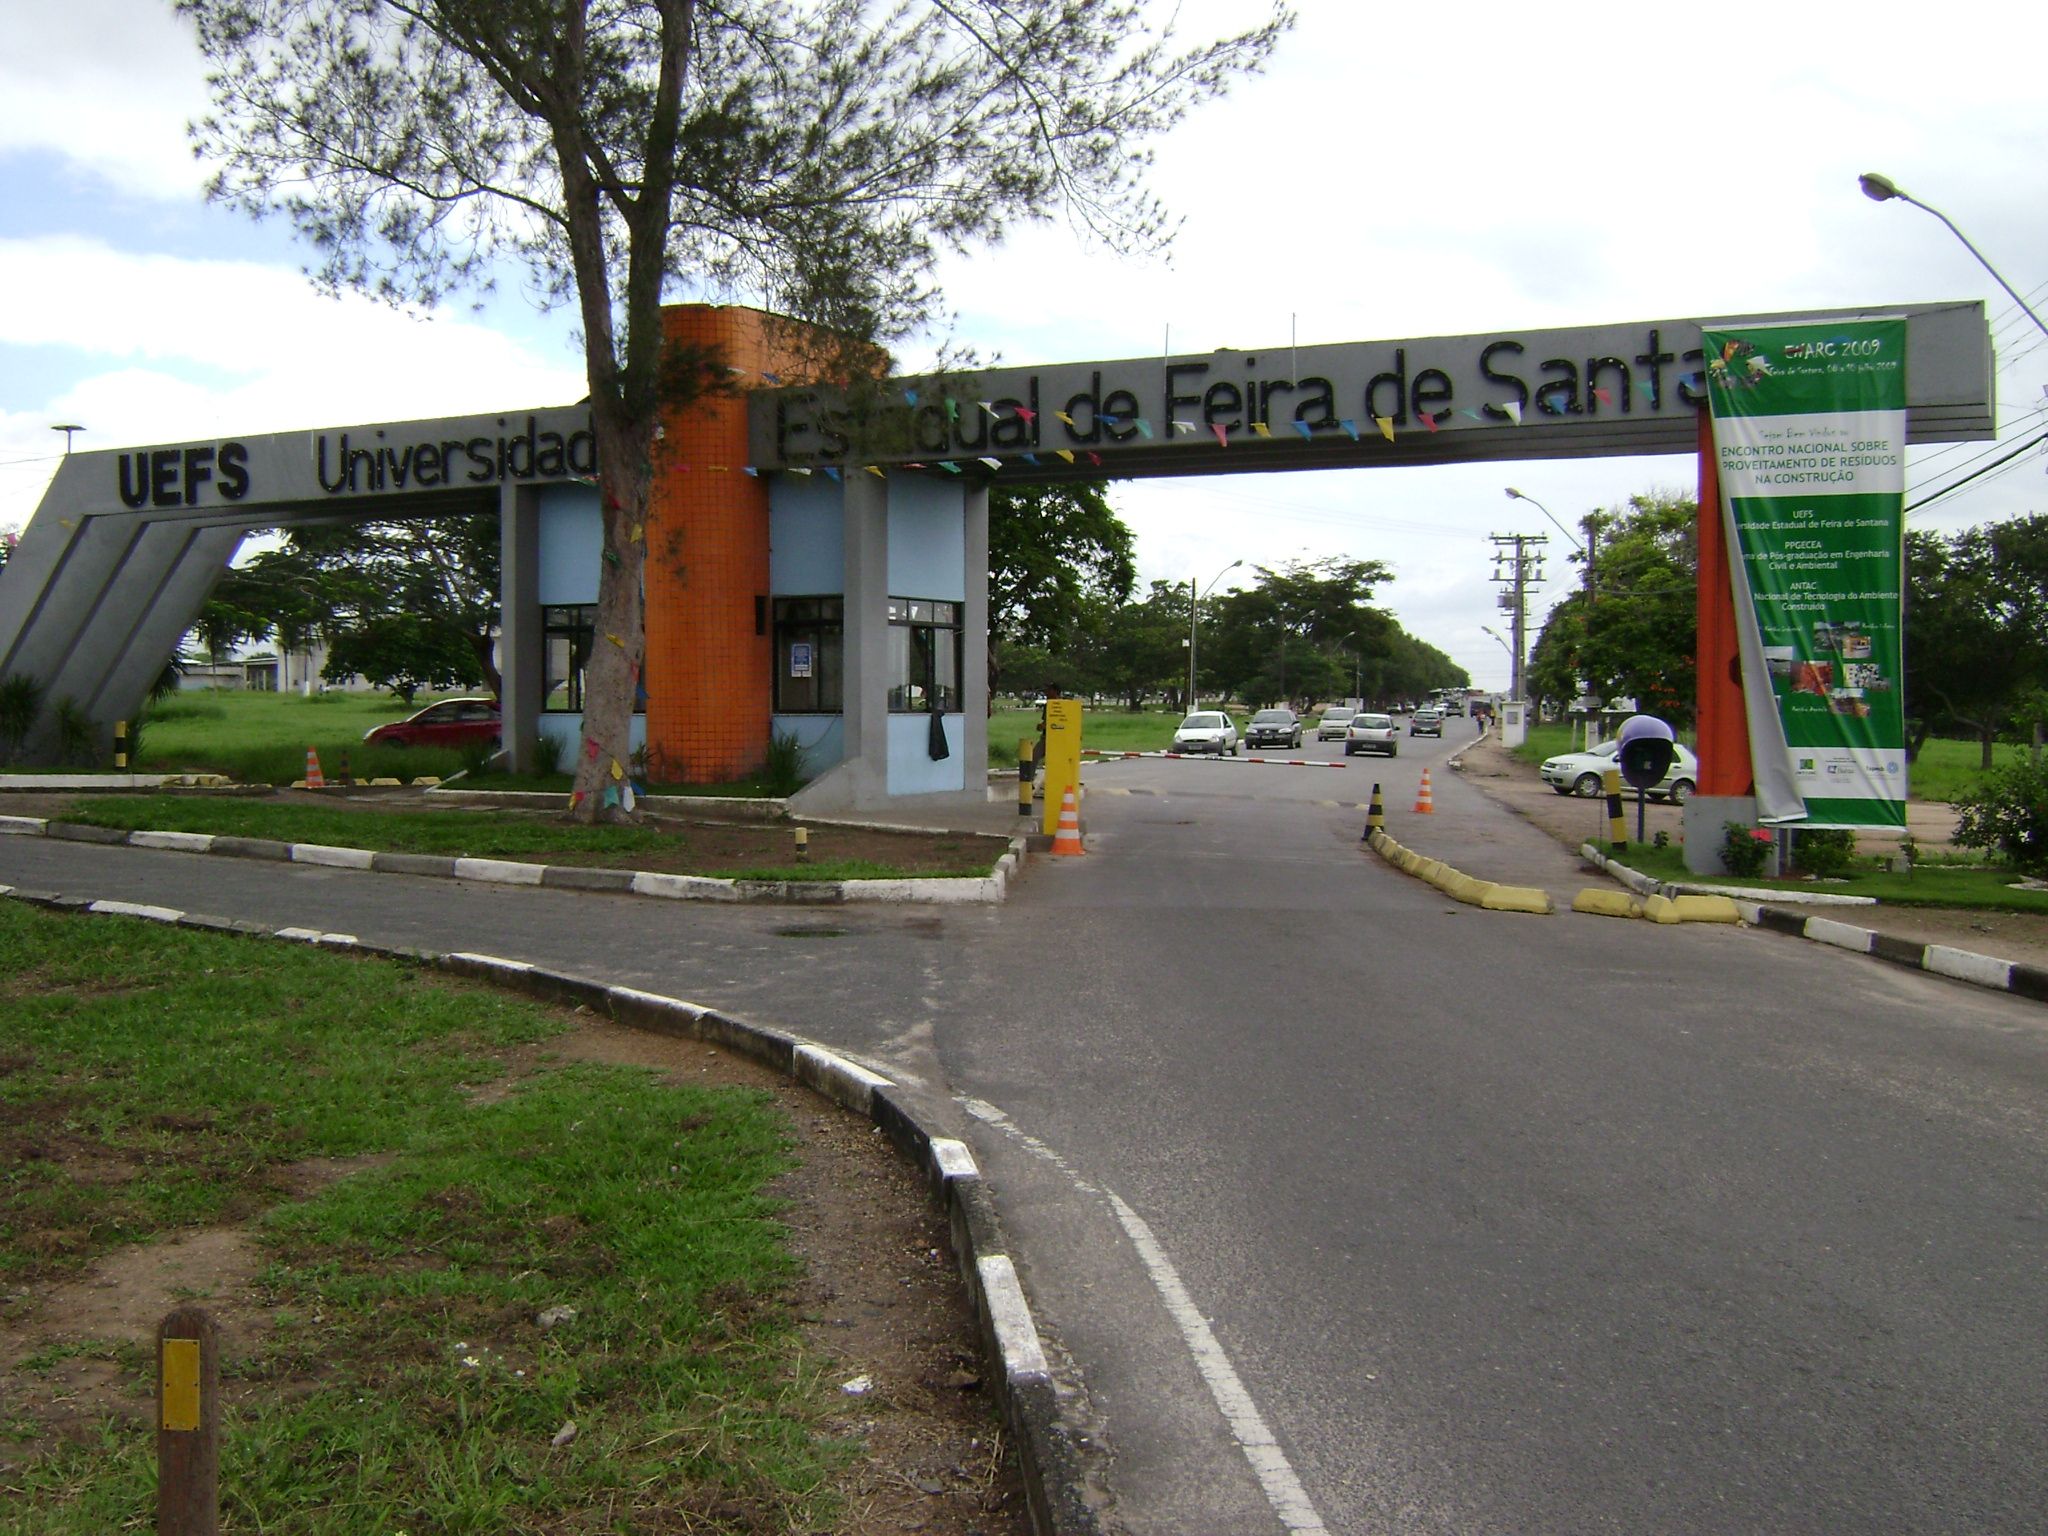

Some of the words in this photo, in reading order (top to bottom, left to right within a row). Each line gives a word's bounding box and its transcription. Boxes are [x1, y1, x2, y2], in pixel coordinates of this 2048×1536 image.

[1842, 339, 1881, 357] 2009
[1064, 371, 1140, 443] de
[1166, 357, 1340, 439] Feira
[1365, 348, 1453, 425] de
[1721, 445, 1784, 457] ENCONTRO
[1788, 443, 1846, 455] NACIONAL
[1851, 441, 1889, 452] SOBRE
[1821, 457, 1836, 468] DE
[1840, 455, 1897, 467] RESÍDUOS
[118, 442, 249, 508] UEFS
[1755, 474, 1771, 485] NA
[1775, 470, 1855, 485] CONSTRUÇÃO
[1792, 510, 1814, 519] UEFS
[1772, 520, 1807, 530] Estadual
[1808, 520, 1819, 528] de
[1820, 519, 1842, 528] Feira
[1844, 519, 1854, 528] de
[1855, 518, 1889, 528] Santana
[1757, 552, 1768, 560] de
[1845, 550, 1890, 560] Engenharia
[1769, 561, 1787, 570] Civil
[1796, 561, 1838, 570] Ambiental
[1790, 581, 1817, 590] ANTAC
[1754, 592, 1789, 601] Nacional
[1803, 592, 1846, 602] Tecnologia
[1859, 591, 1899, 600] Ambiente
